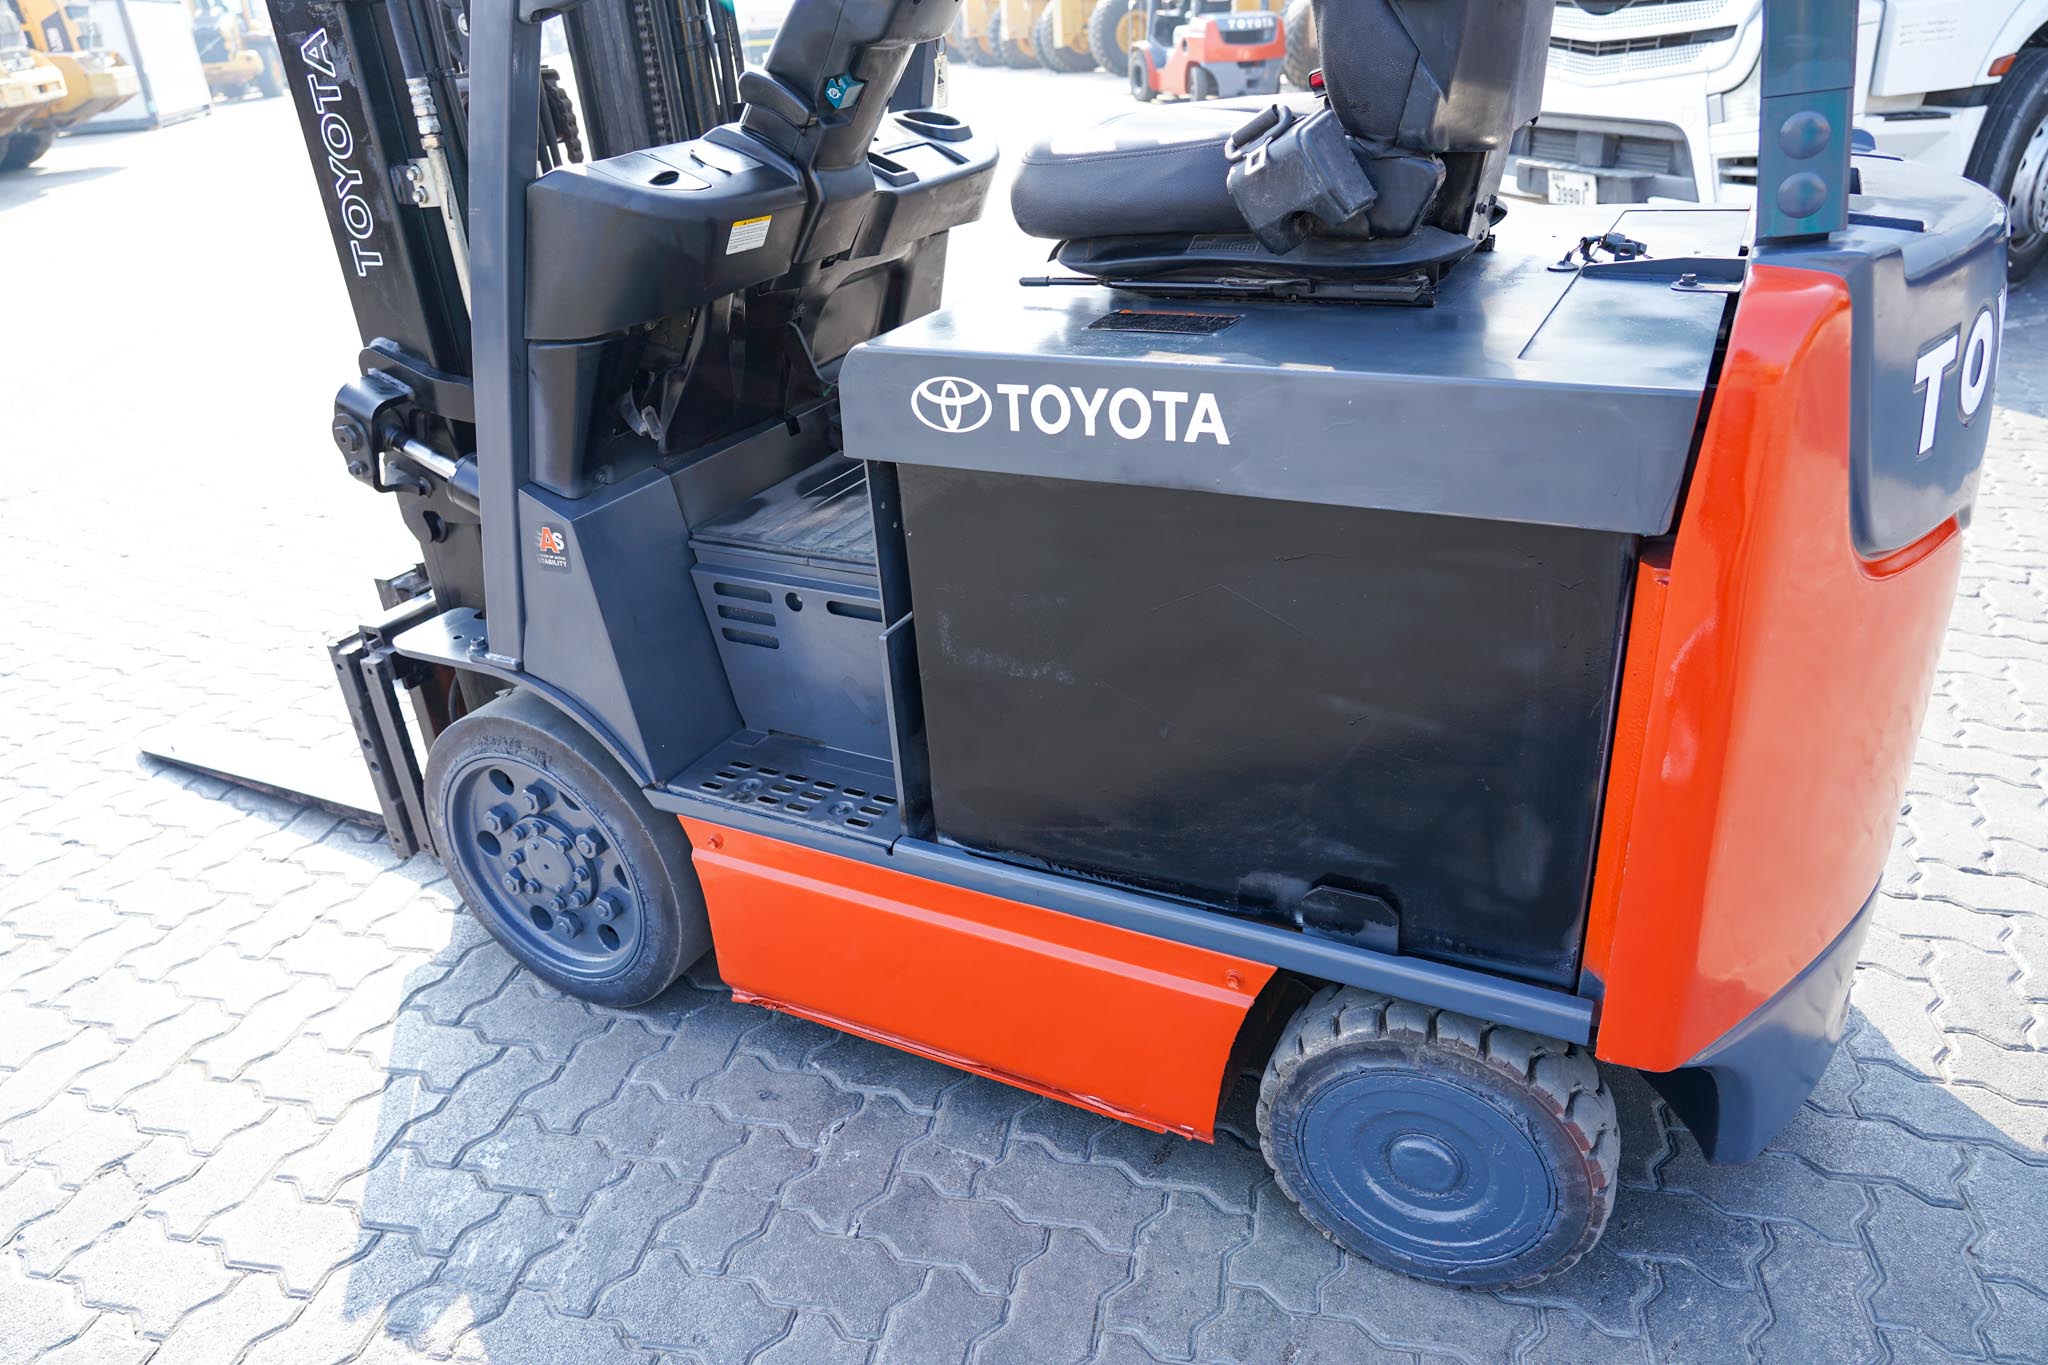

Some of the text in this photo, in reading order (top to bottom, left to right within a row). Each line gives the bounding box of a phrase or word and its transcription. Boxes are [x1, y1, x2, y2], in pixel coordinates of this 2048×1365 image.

[1228, 17, 1274, 30] TOYOTA
[301, 28, 384, 277] TOYOTA
[997, 383, 1231, 446] TOYOTA
[540, 526, 565, 554] AS
